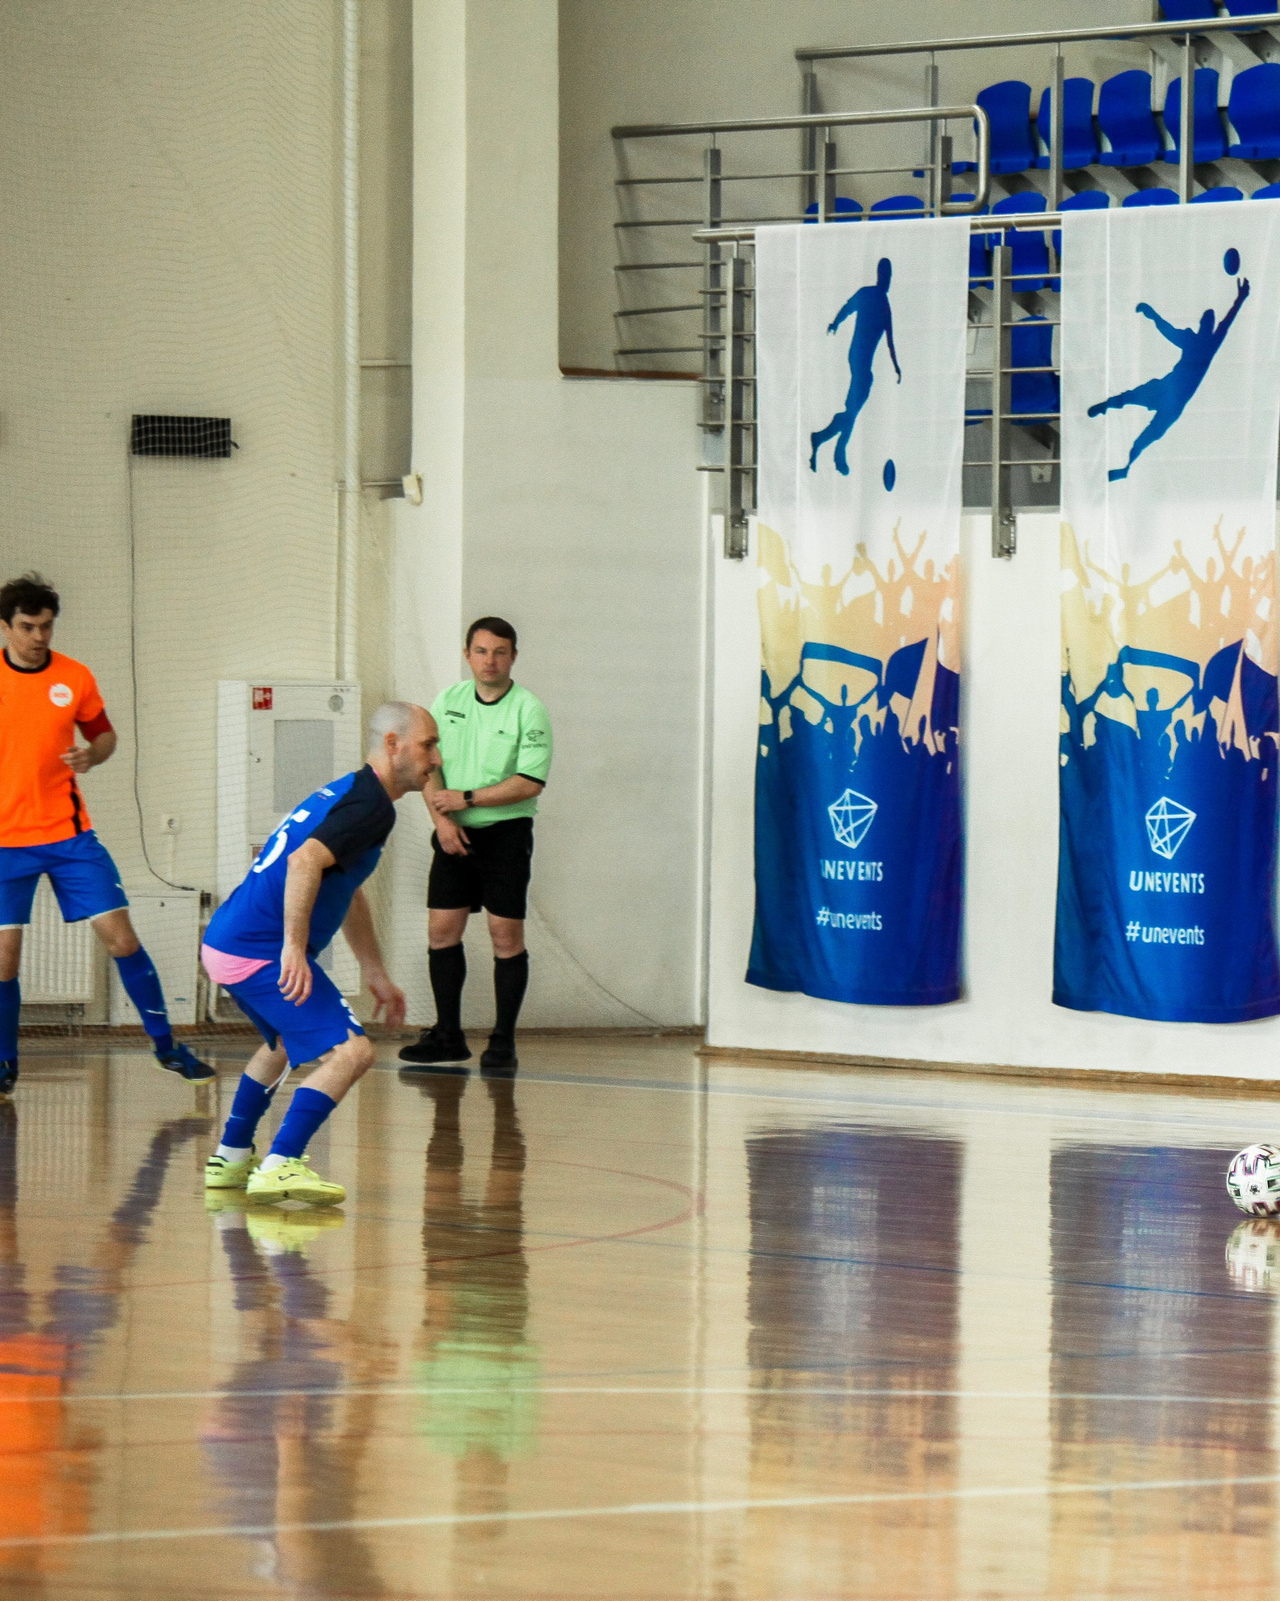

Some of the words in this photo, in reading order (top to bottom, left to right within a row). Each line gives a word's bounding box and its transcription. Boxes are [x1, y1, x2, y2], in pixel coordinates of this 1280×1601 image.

[1129, 870, 1205, 894] UNEVENTS
[816, 906, 883, 931] #unevents
[1126, 920, 1205, 945] #unevents
